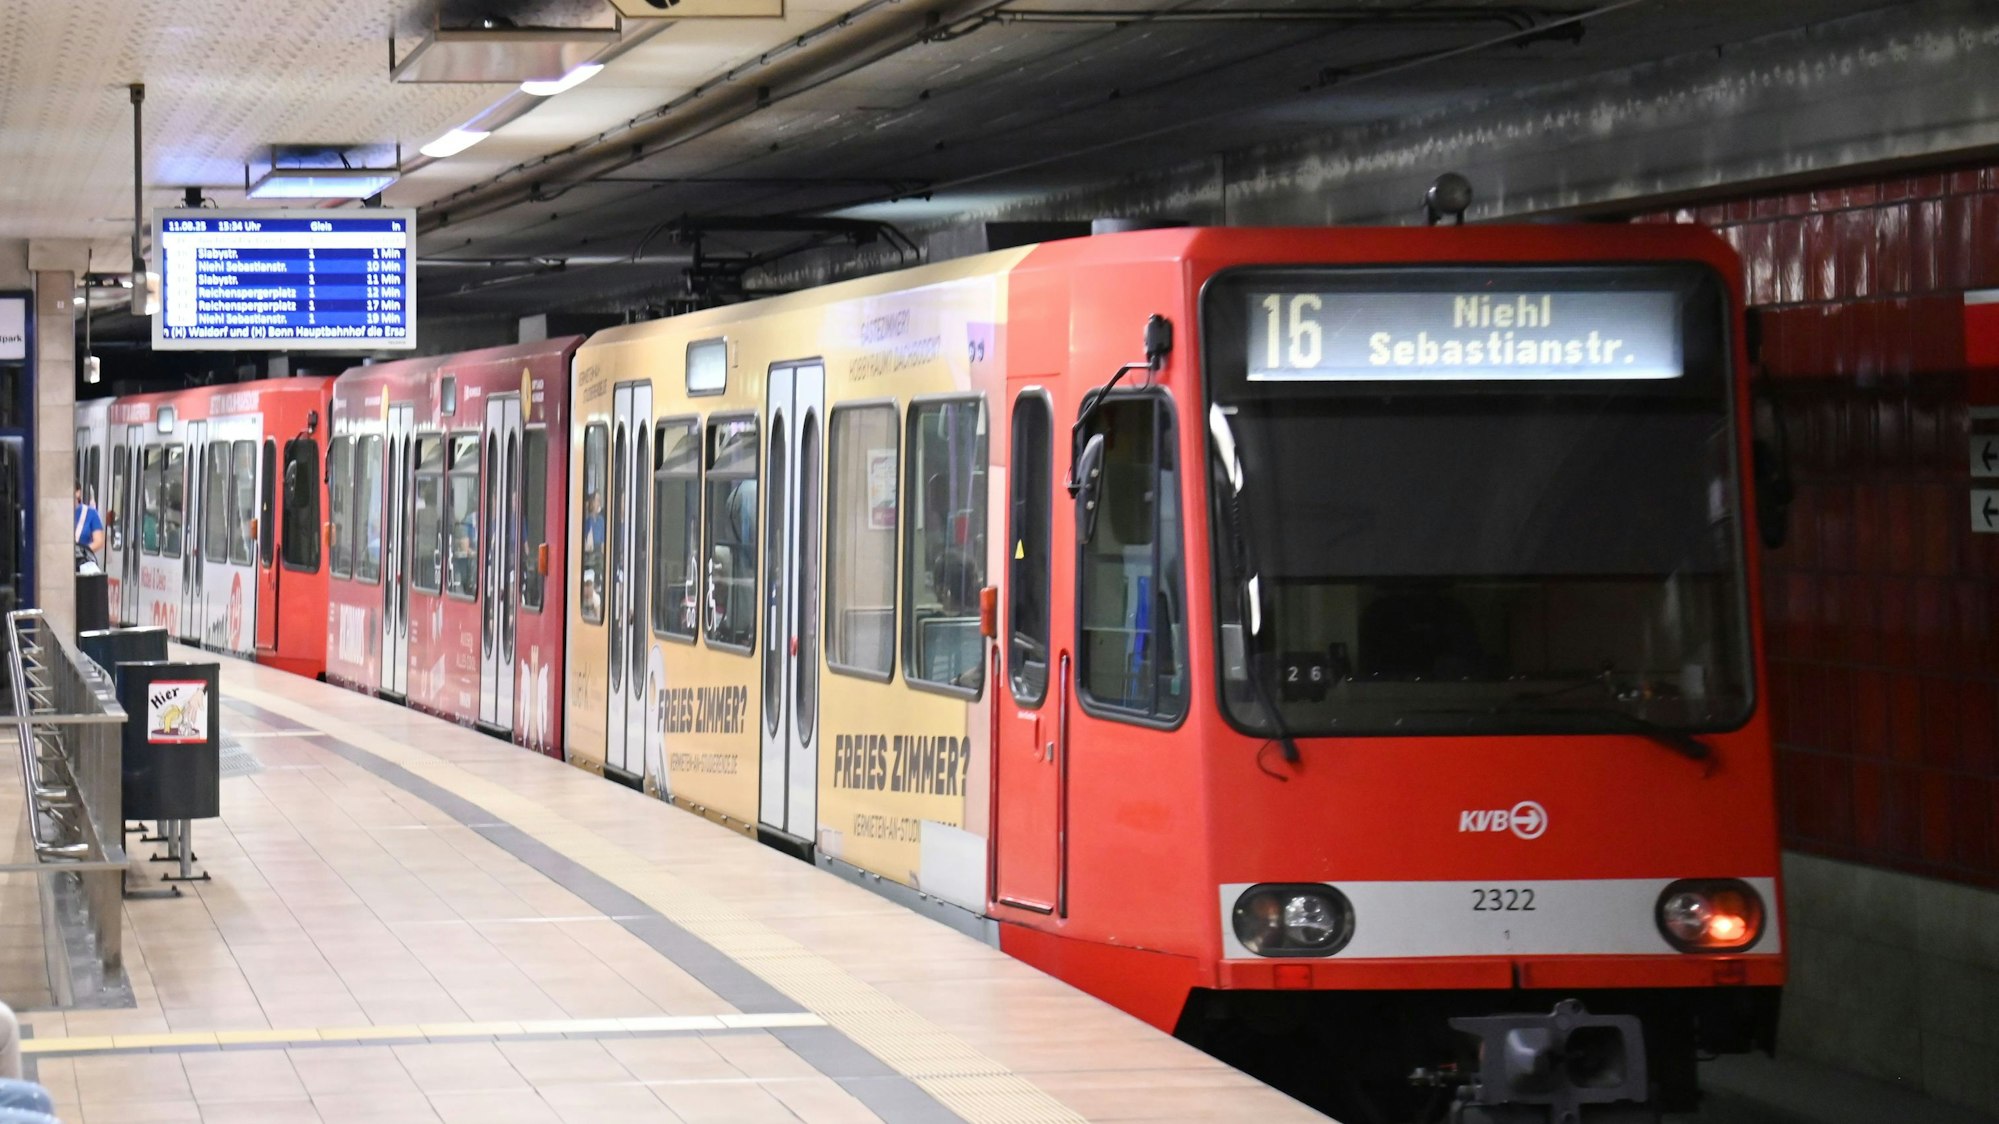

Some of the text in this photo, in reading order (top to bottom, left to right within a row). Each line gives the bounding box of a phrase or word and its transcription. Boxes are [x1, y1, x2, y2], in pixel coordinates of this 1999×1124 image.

[244, 222, 261, 232] Uhr
[310, 222, 332, 232] Gleis
[381, 249, 401, 259] Min
[199, 261, 224, 272] Niehl
[381, 261, 401, 272] Min
[381, 274, 401, 285] Min
[381, 287, 401, 298] Min
[381, 300, 401, 311] Min
[1452, 294, 1553, 329] Niehl
[199, 313, 224, 324] Niehl
[381, 313, 401, 324] Min
[230, 326, 249, 337] und
[268, 326, 294, 337] Bonn
[295, 326, 366, 339] Hauptbahnhof
[367, 326, 384, 337] die
[1262, 292, 1323, 370] 16
[1368, 331, 1635, 367] Sebastianstr.
[150, 687, 180, 710] Hier
[657, 685, 748, 735] FREIES ZIMMER?
[834, 733, 972, 797] FREIES ZIMMER?
[1458, 809, 1509, 833] KVB
[1472, 888, 1537, 911] 2322
